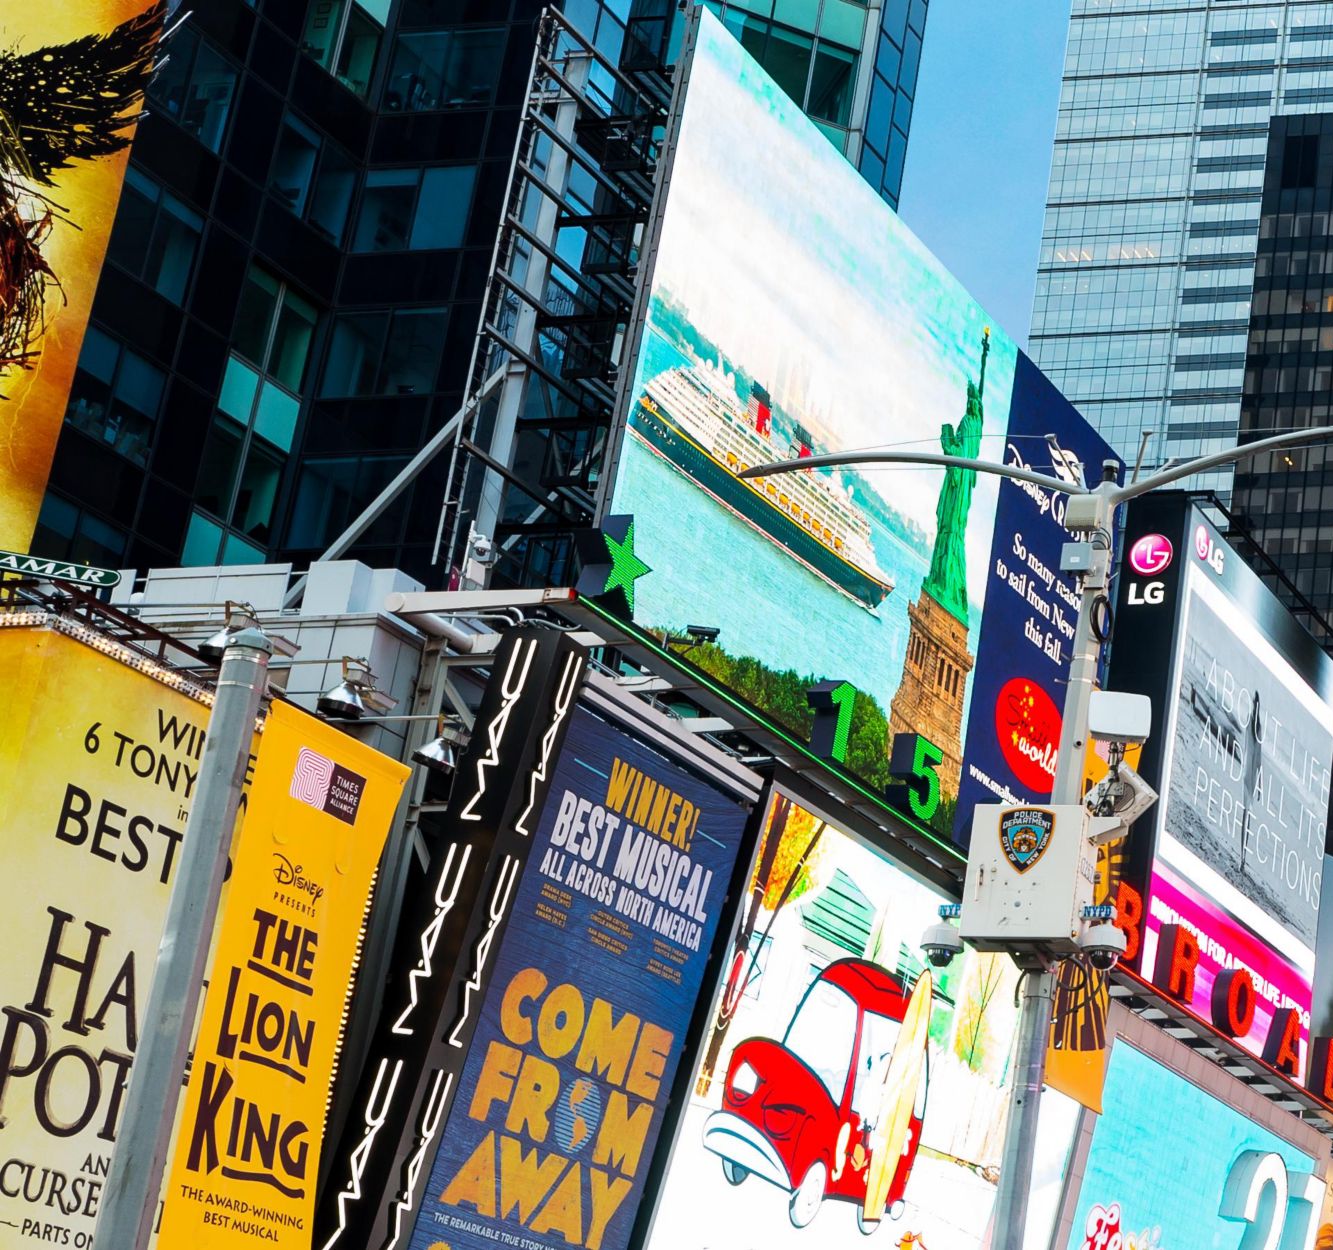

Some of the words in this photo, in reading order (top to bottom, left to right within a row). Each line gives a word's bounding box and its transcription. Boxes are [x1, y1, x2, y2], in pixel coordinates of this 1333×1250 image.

[1012, 533, 1026, 560] So
[1027, 552, 1055, 591] many
[1207, 539, 1225, 575] LG
[996, 559, 1007, 579] to
[1008, 571, 1027, 597] sail
[1027, 580, 1050, 620] from
[1051, 603, 1076, 640] New
[1127, 581, 1165, 605] LG
[1024, 617, 1043, 648] this
[1043, 632, 1062, 665] fall.
[84, 722, 102, 754] 6
[1206, 658, 1282, 755] ABOUT
[1290, 738, 1331, 808] LIFE
[330, 785, 359, 807] SQUARE
[336, 775, 359, 794] TIMES
[1199, 716, 1244, 782] AND
[1253, 765, 1288, 828] ALL
[1298, 804, 1326, 861] ITS
[329, 798, 354, 815] ALLIANCE
[605, 756, 700, 852] WINNER!
[1013, 811, 1044, 820] POLICE
[55, 782, 184, 885] BEST
[1002, 817, 1052, 830] DEPARTMENT
[1194, 766, 1322, 911] PERFECTIONS
[550, 789, 620, 868] BEST
[612, 824, 713, 923] MUSICAL
[1002, 836, 1012, 852] CITY
[1008, 853, 1018, 862] OF
[1026, 850, 1039, 865] NEW
[1038, 832, 1050, 850] YORK
[273, 891, 316, 919] PRESENTS
[539, 847, 566, 882] ALL
[564, 860, 617, 907] ACROSS
[615, 886, 655, 928] NORTH
[652, 905, 703, 952] AMERICA
[1083, 905, 1112, 918] NYPD
[252, 908, 319, 981] THE
[501, 967, 674, 1101] COME
[181, 1184, 204, 1202] THE
[205, 1189, 304, 1230] AWARD-WINNING
[438, 1130, 633, 1250] AWAY
[21, 1217, 71, 1246] PARTS
[203, 1211, 230, 1231] BEST
[231, 1218, 279, 1242] MUSICAL
[434, 1212, 449, 1225] THE
[449, 1217, 501, 1241] REMARKABLE
[500, 1232, 519, 1246] TRUE
